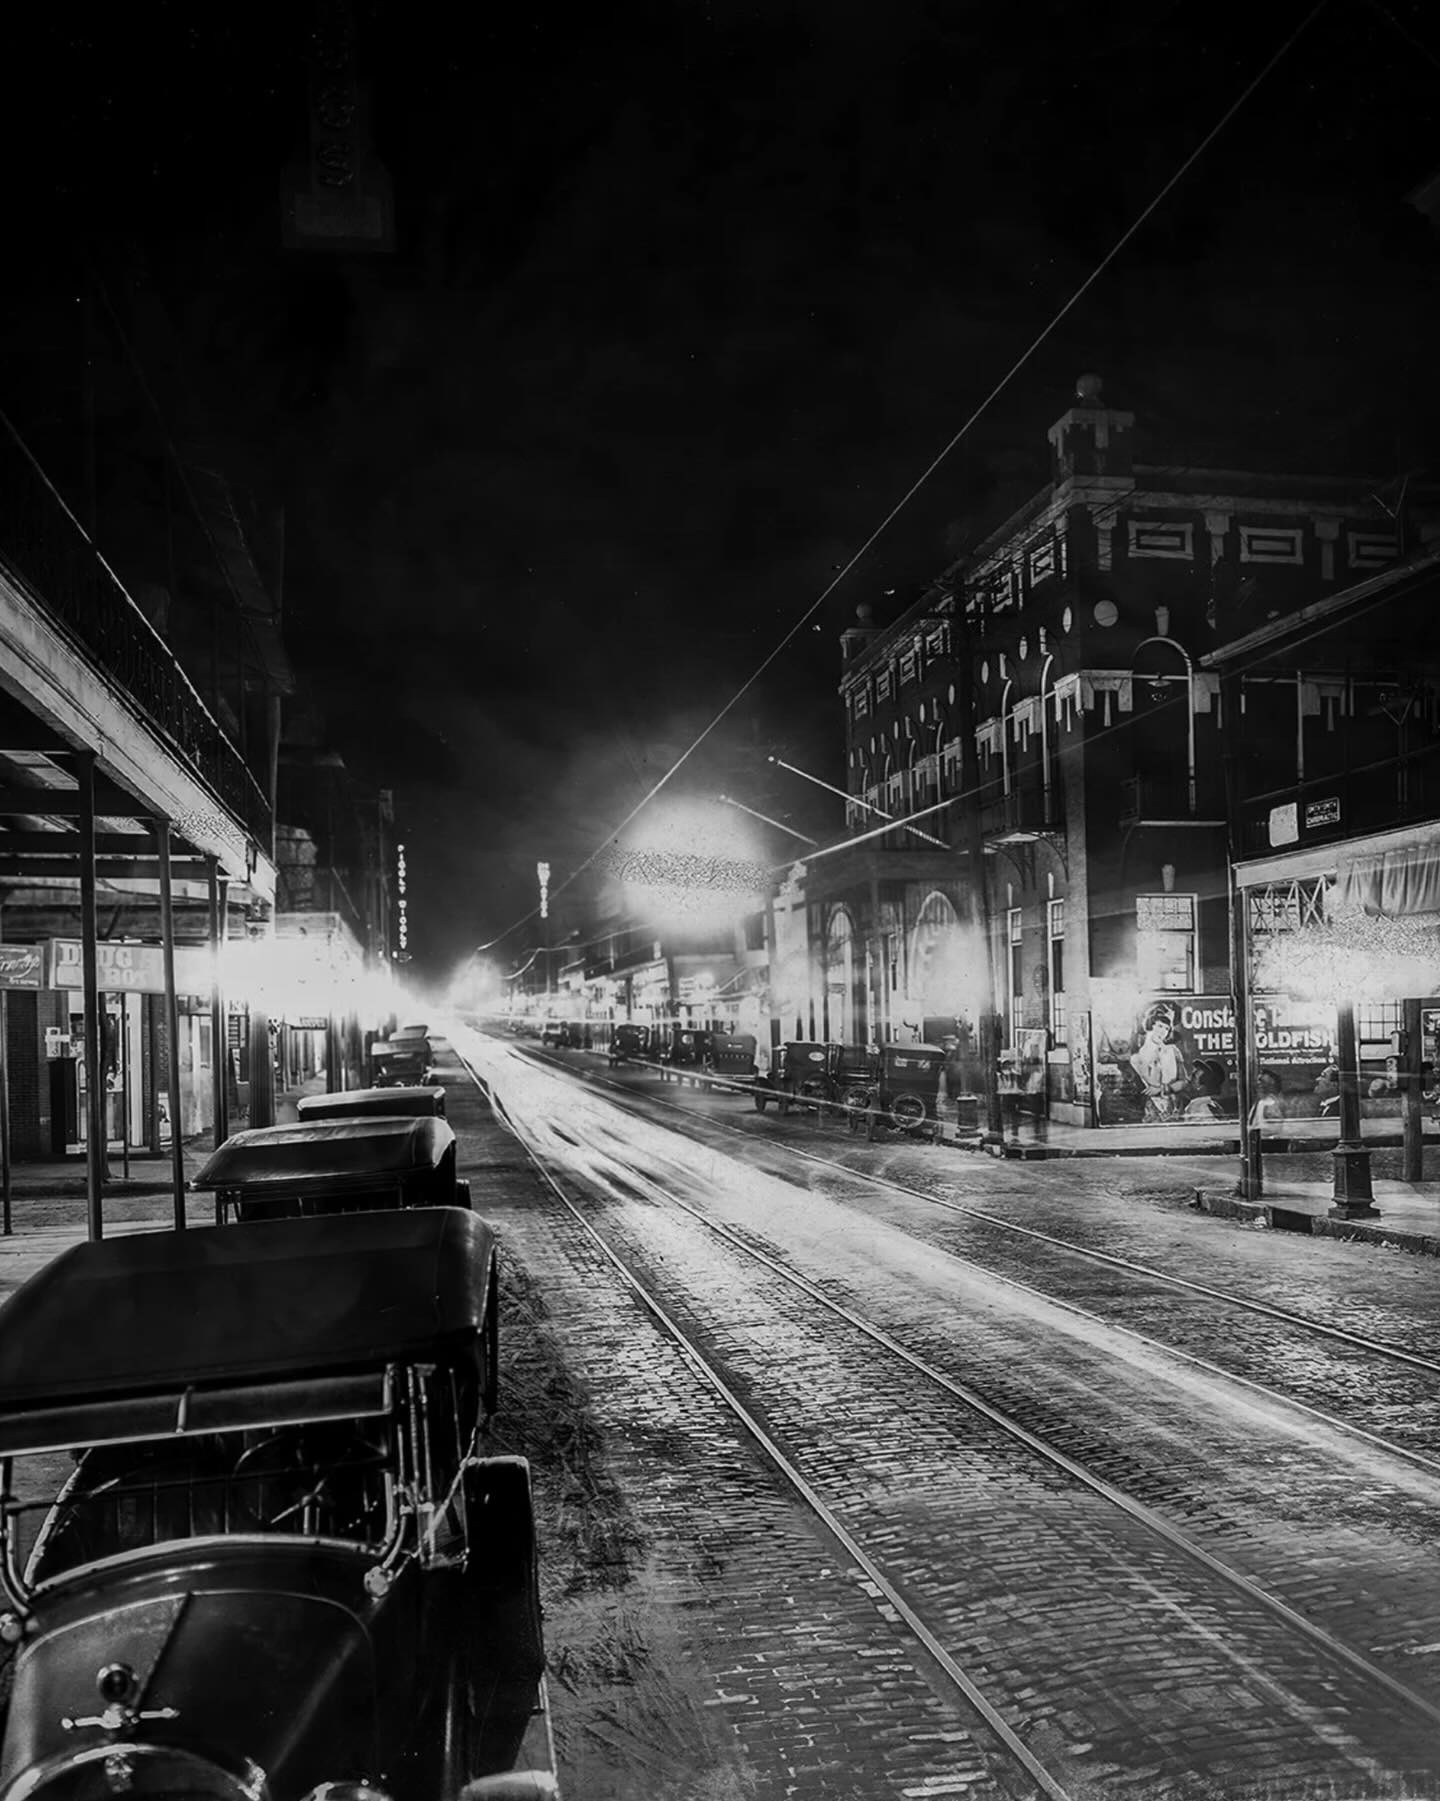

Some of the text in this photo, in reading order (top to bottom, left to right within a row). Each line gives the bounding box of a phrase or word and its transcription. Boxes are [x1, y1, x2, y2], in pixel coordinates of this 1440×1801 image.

[60, 944, 133, 968] DUG
[1193, 1030, 1335, 1050] THE OLDFISH
